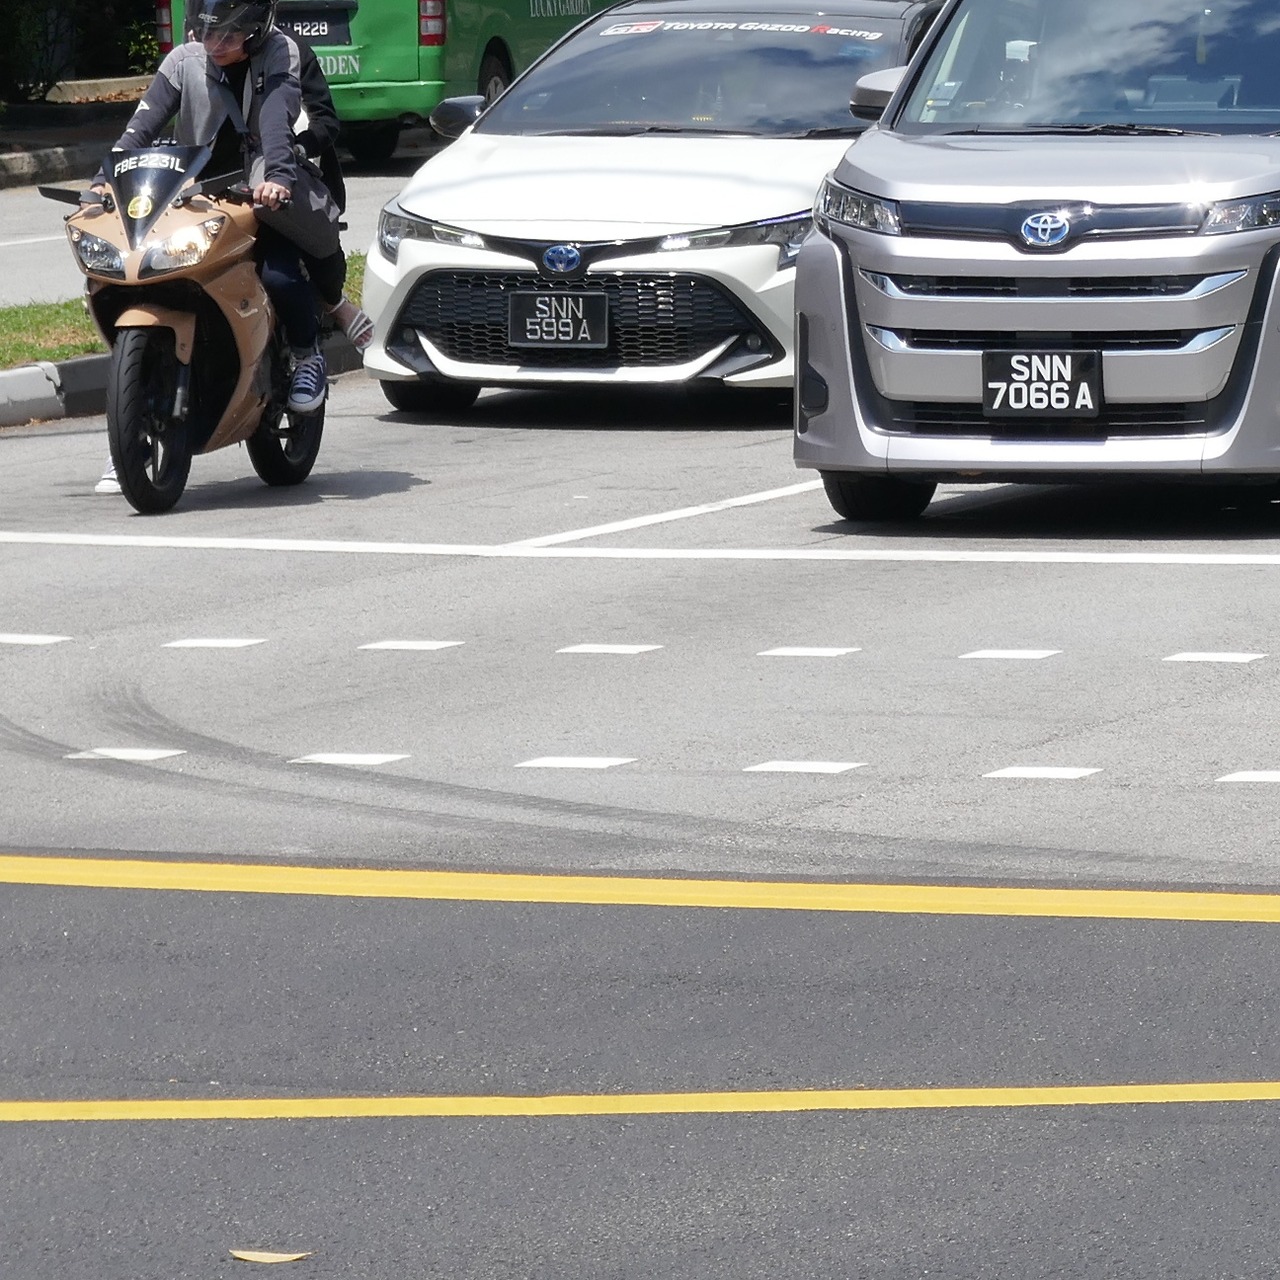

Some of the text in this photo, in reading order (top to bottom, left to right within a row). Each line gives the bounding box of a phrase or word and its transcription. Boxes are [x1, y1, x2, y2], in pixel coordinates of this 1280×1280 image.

[663, 22, 738, 31] TOYOTA
[738, 22, 811, 33] GAZOO
[811, 23, 884, 40] Racing
[317, 55, 361, 76] RDEN
[535, 297, 583, 319] SNN
[526, 318, 592, 341] 599 A
[1010, 354, 1072, 382] SNN
[987, 382, 1094, 410] 7066 A
